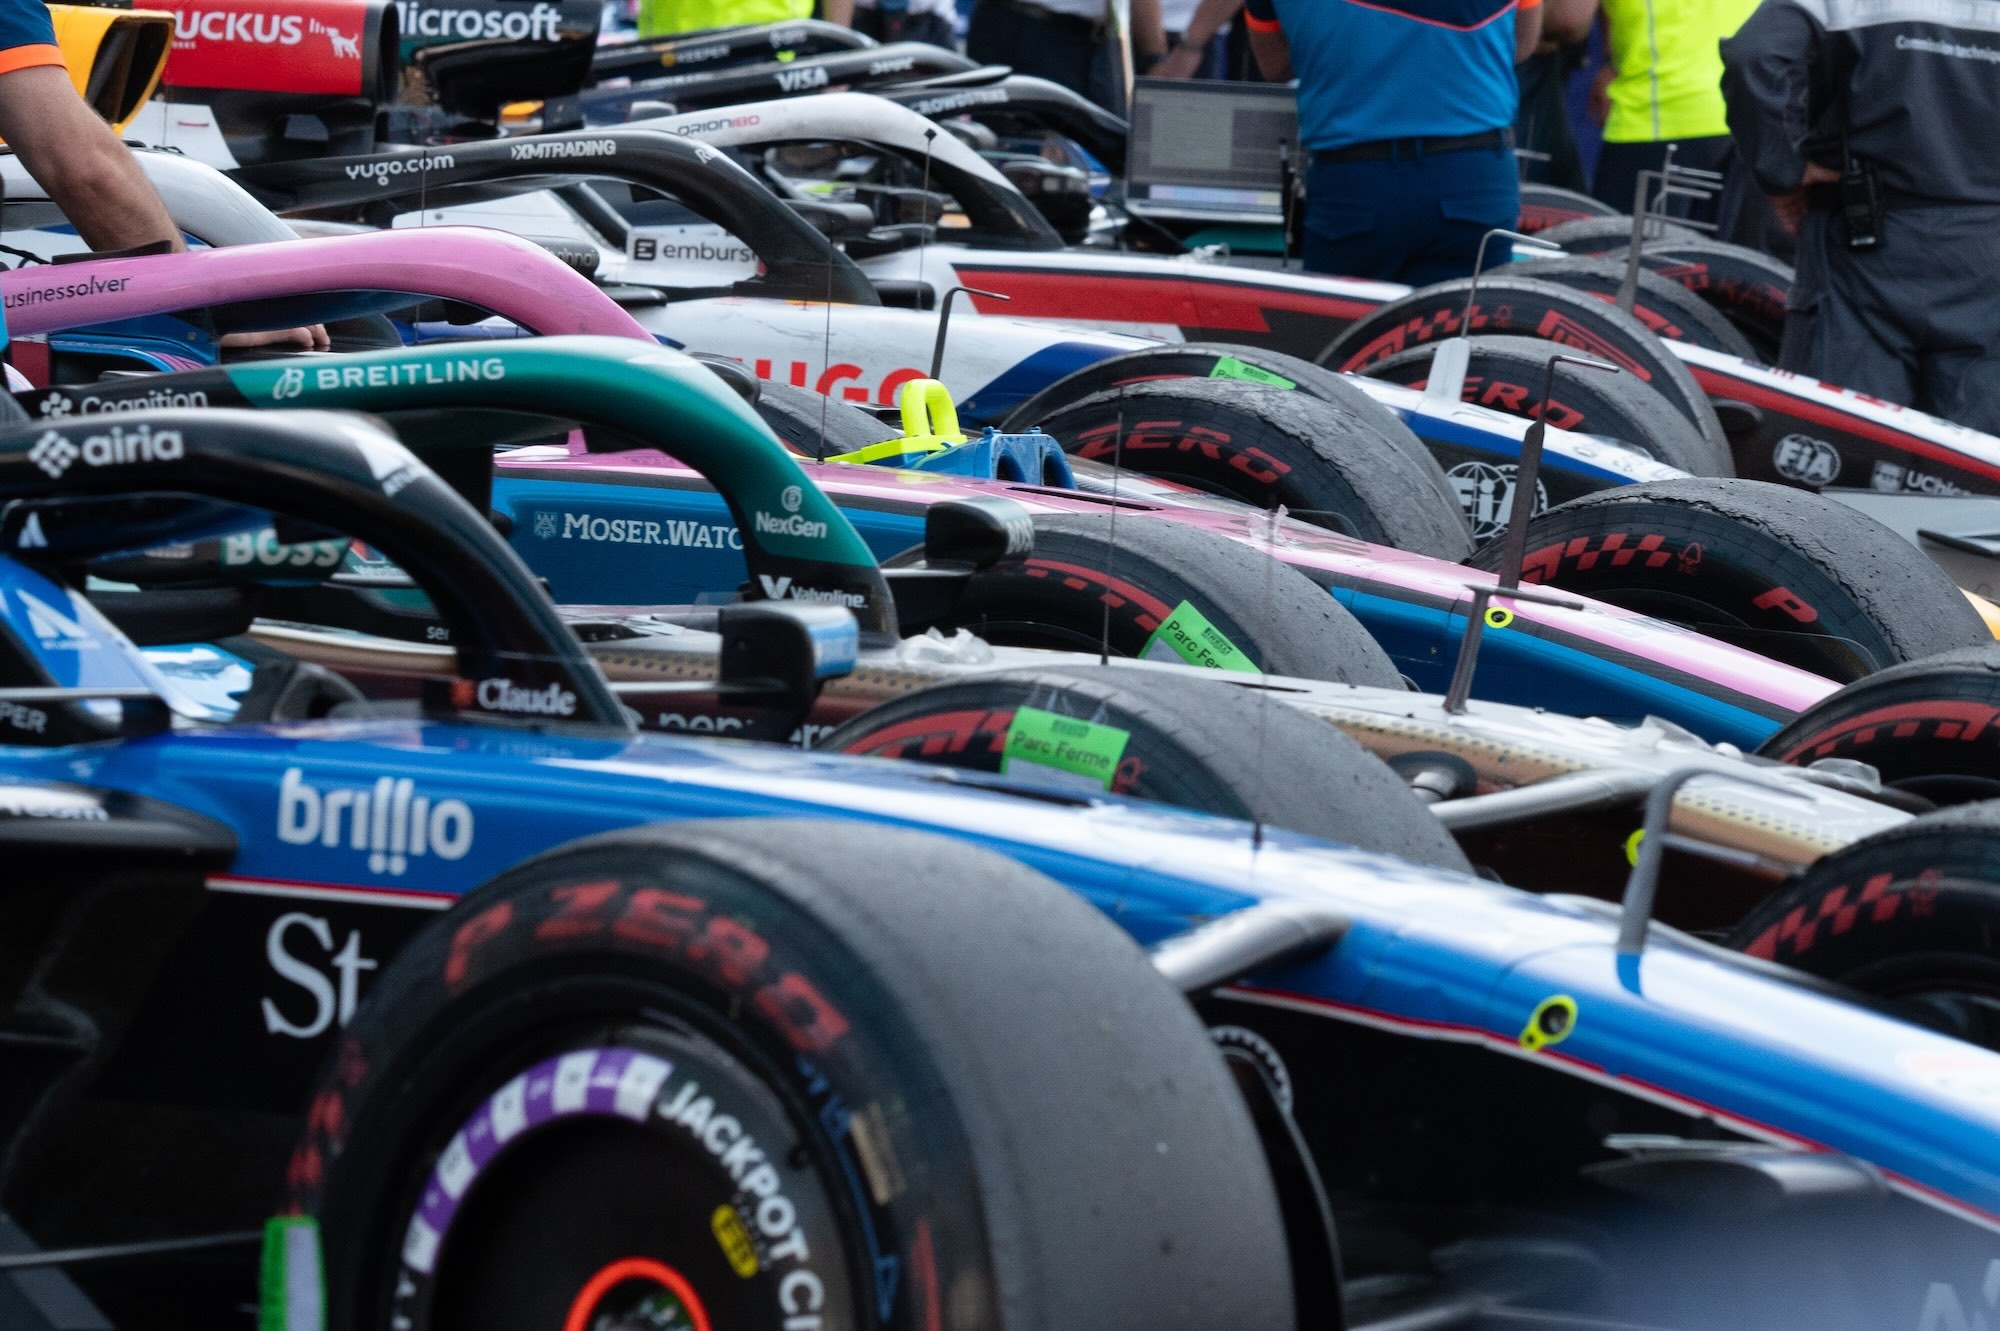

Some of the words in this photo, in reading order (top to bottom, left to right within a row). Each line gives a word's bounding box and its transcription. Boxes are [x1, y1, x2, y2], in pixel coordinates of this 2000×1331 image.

[174, 10, 302, 45] UCKUS
[774, 66, 829, 92] VISA
[345, 155, 454, 186] yugo.com
[4, 275, 131, 309] usinessolver
[317, 358, 505, 390] BREITLING
[82, 424, 185, 466] airia
[1076, 420, 1292, 484] ZERO
[562, 512, 744, 550] MOSER.WATC
[756, 511, 827, 538] NexGen
[1753, 586, 1819, 623] P
[1166, 620, 1198, 652] Parc
[477, 677, 577, 716] Claude
[1012, 730, 1051, 754] Parc
[1054, 741, 1111, 769] Ferme
[277, 767, 474, 876] brillio
[262, 911, 378, 1038] St
[444, 902, 514, 986] P
[535, 879, 851, 1054] ZERO
[657, 1080, 810, 1264] JACKPOT
[779, 1268, 825, 1331] CI
